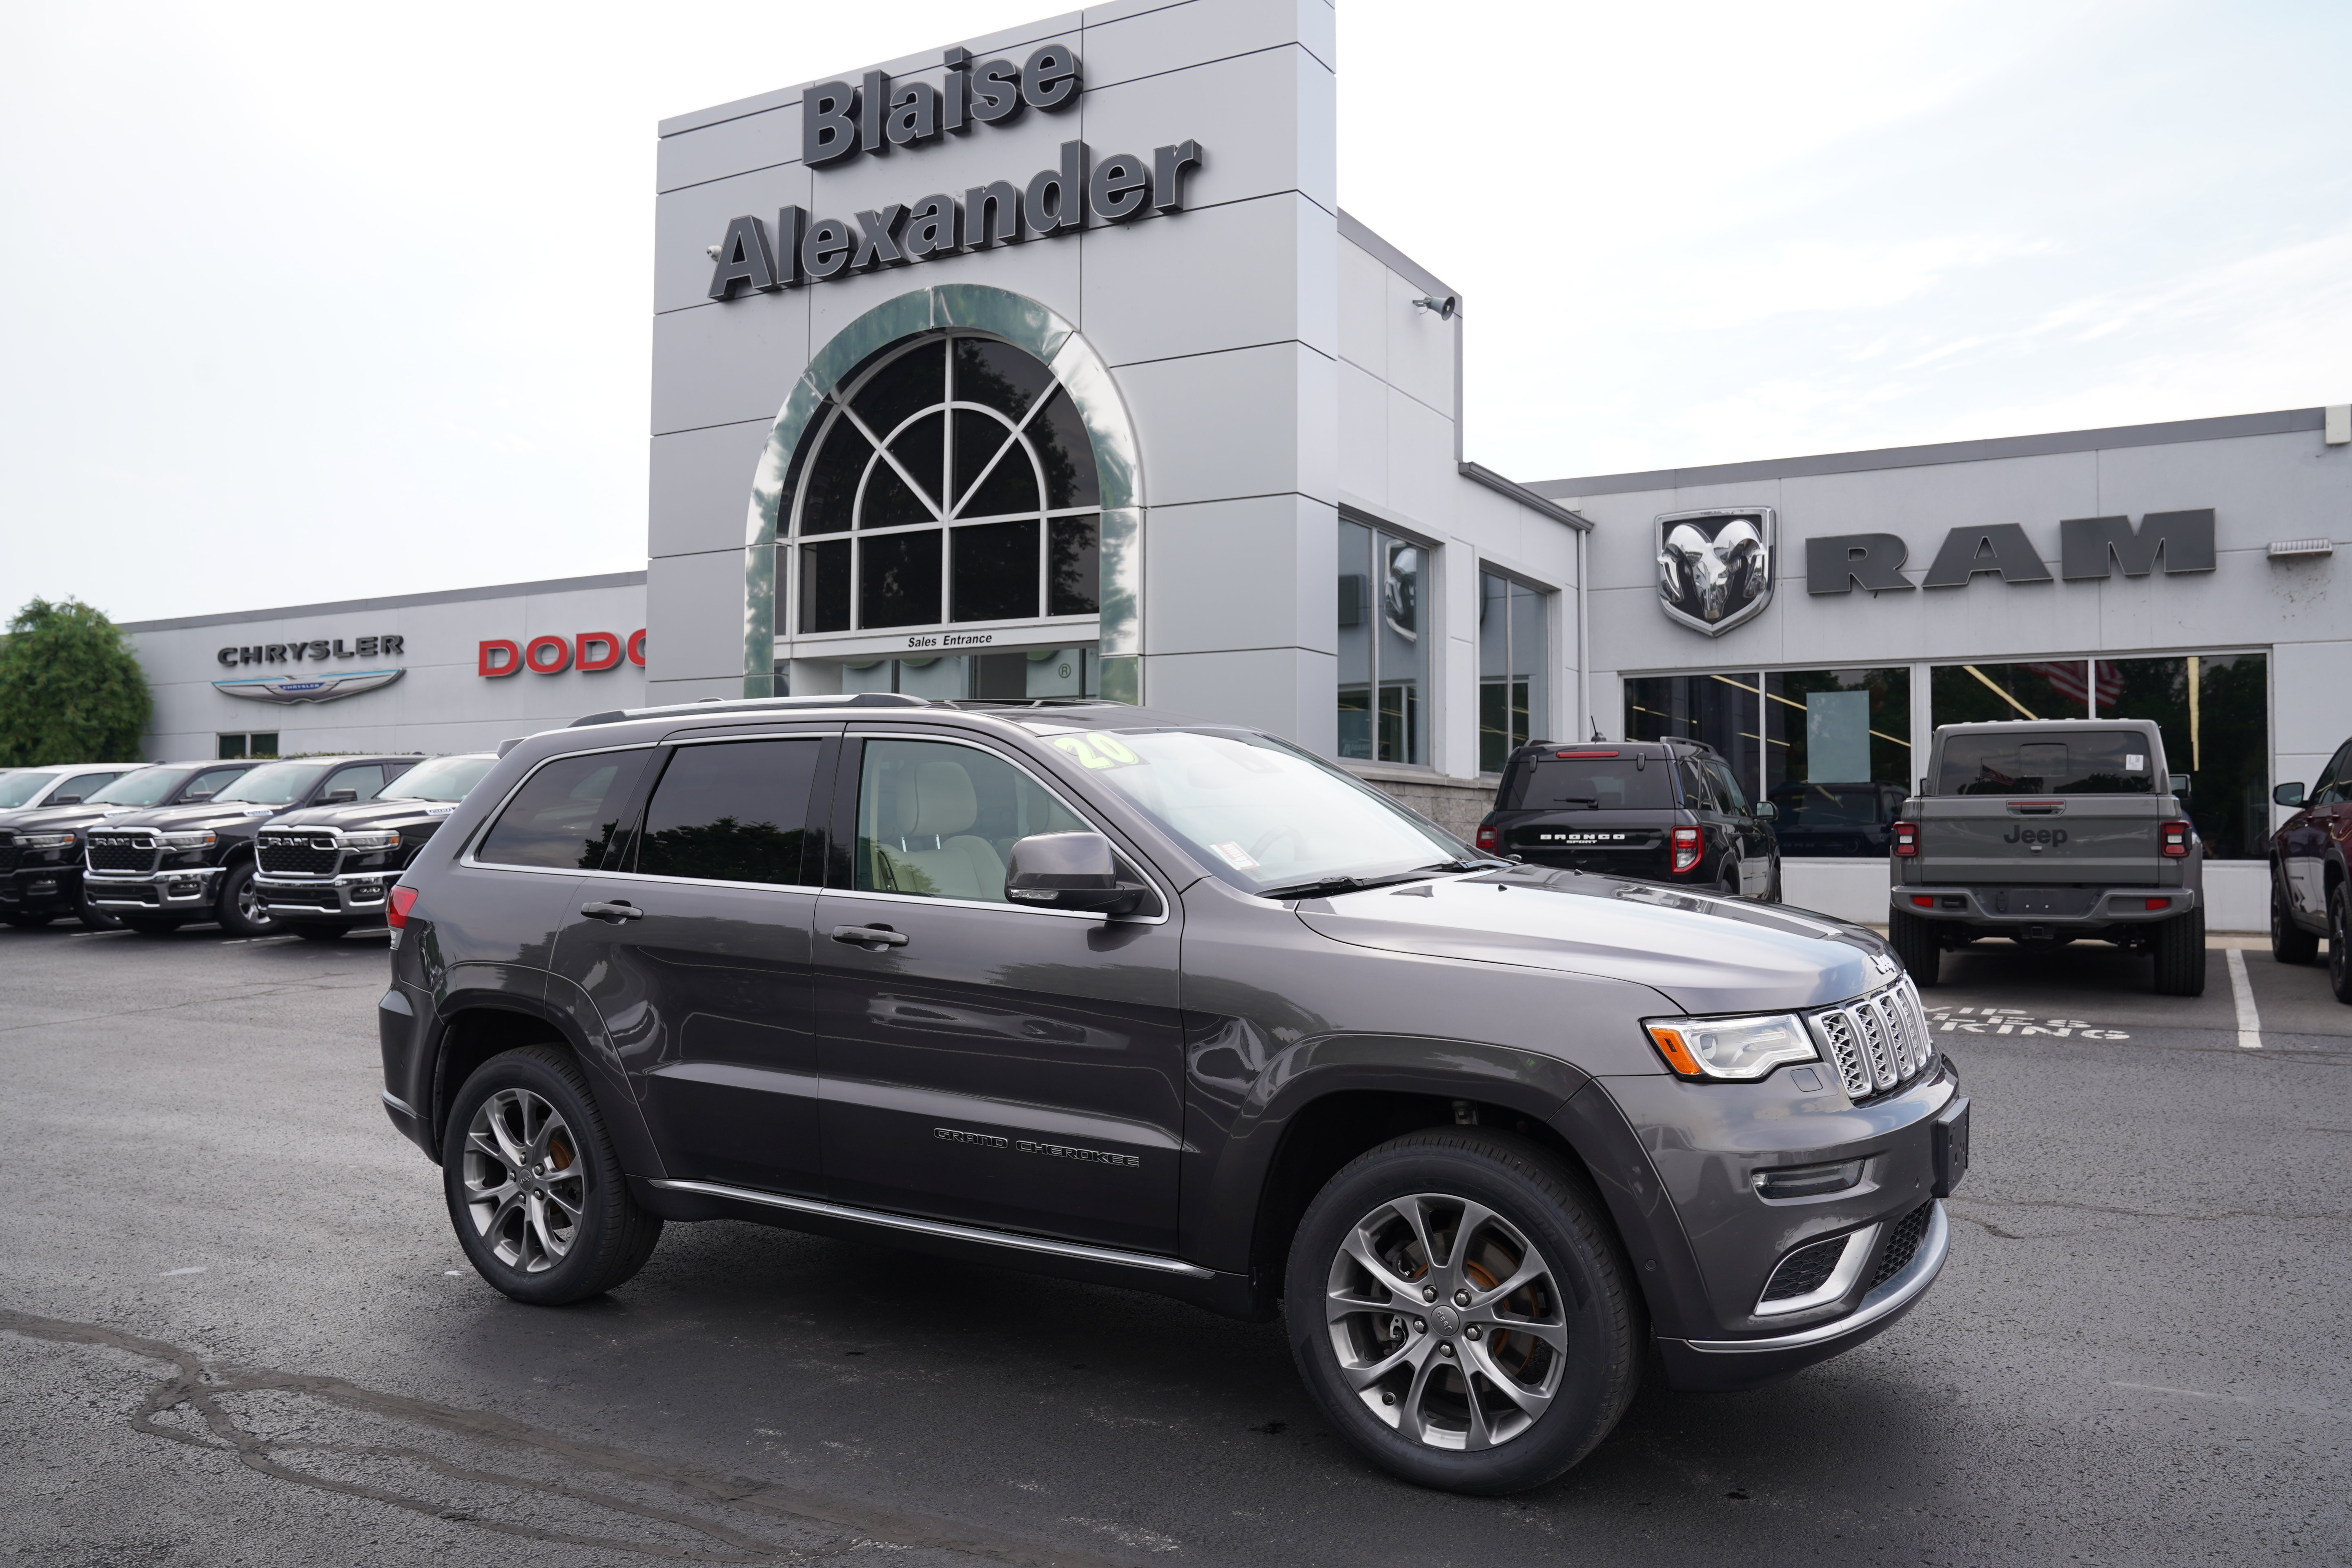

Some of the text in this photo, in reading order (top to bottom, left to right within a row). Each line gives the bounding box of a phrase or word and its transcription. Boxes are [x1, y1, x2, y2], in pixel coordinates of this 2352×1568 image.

[802, 43, 1085, 168] Blaise
[707, 139, 1203, 301] Alexander
[1805, 508, 2216, 595] RAM
[217, 635, 405, 666] CHRYSLER
[479, 628, 646, 678] DOD
[909, 635, 992, 647] Sales Entrance
[1054, 733, 1139, 769] 20
[269, 837, 308, 846] RAM
[2004, 824, 2068, 847] Jeep
[1926, 1021, 2130, 1040] KING
[1932, 1013, 2091, 1028] LES
[934, 1128, 1140, 1168] GRAND CHEROKEE
[1436, 1311, 1452, 1331] Jeep
